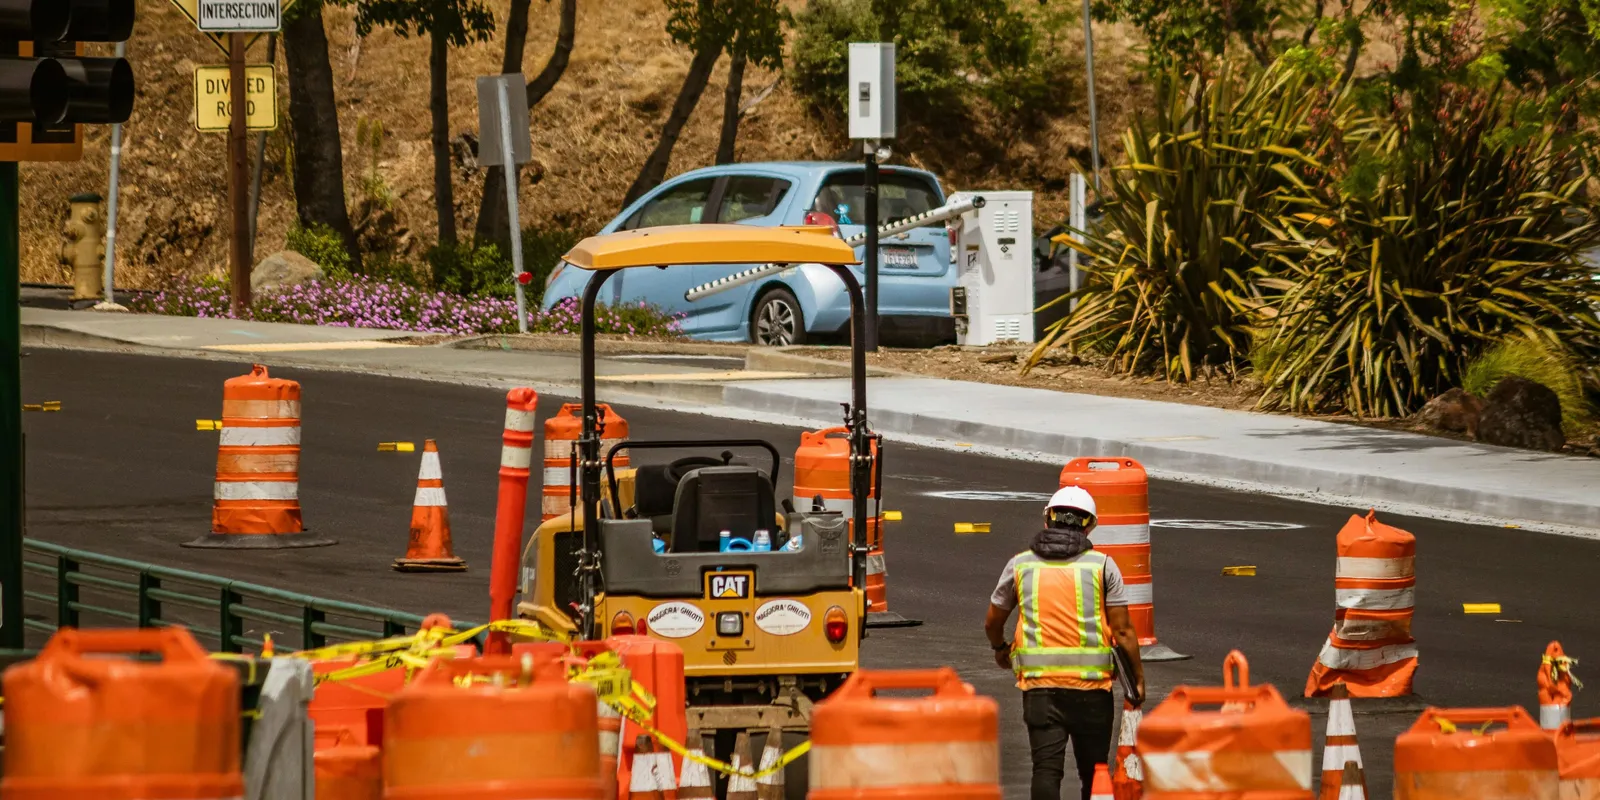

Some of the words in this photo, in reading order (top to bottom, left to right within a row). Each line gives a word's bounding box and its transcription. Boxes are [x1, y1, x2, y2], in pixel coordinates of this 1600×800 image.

[203, 3, 275, 18] INTERSECTION
[206, 78, 265, 94] DIVED
[217, 101, 255, 116] ROD
[712, 576, 746, 597] CAT
[680, 606, 703, 622] GHILOTTI
[787, 604, 810, 620] GHILOTTI
